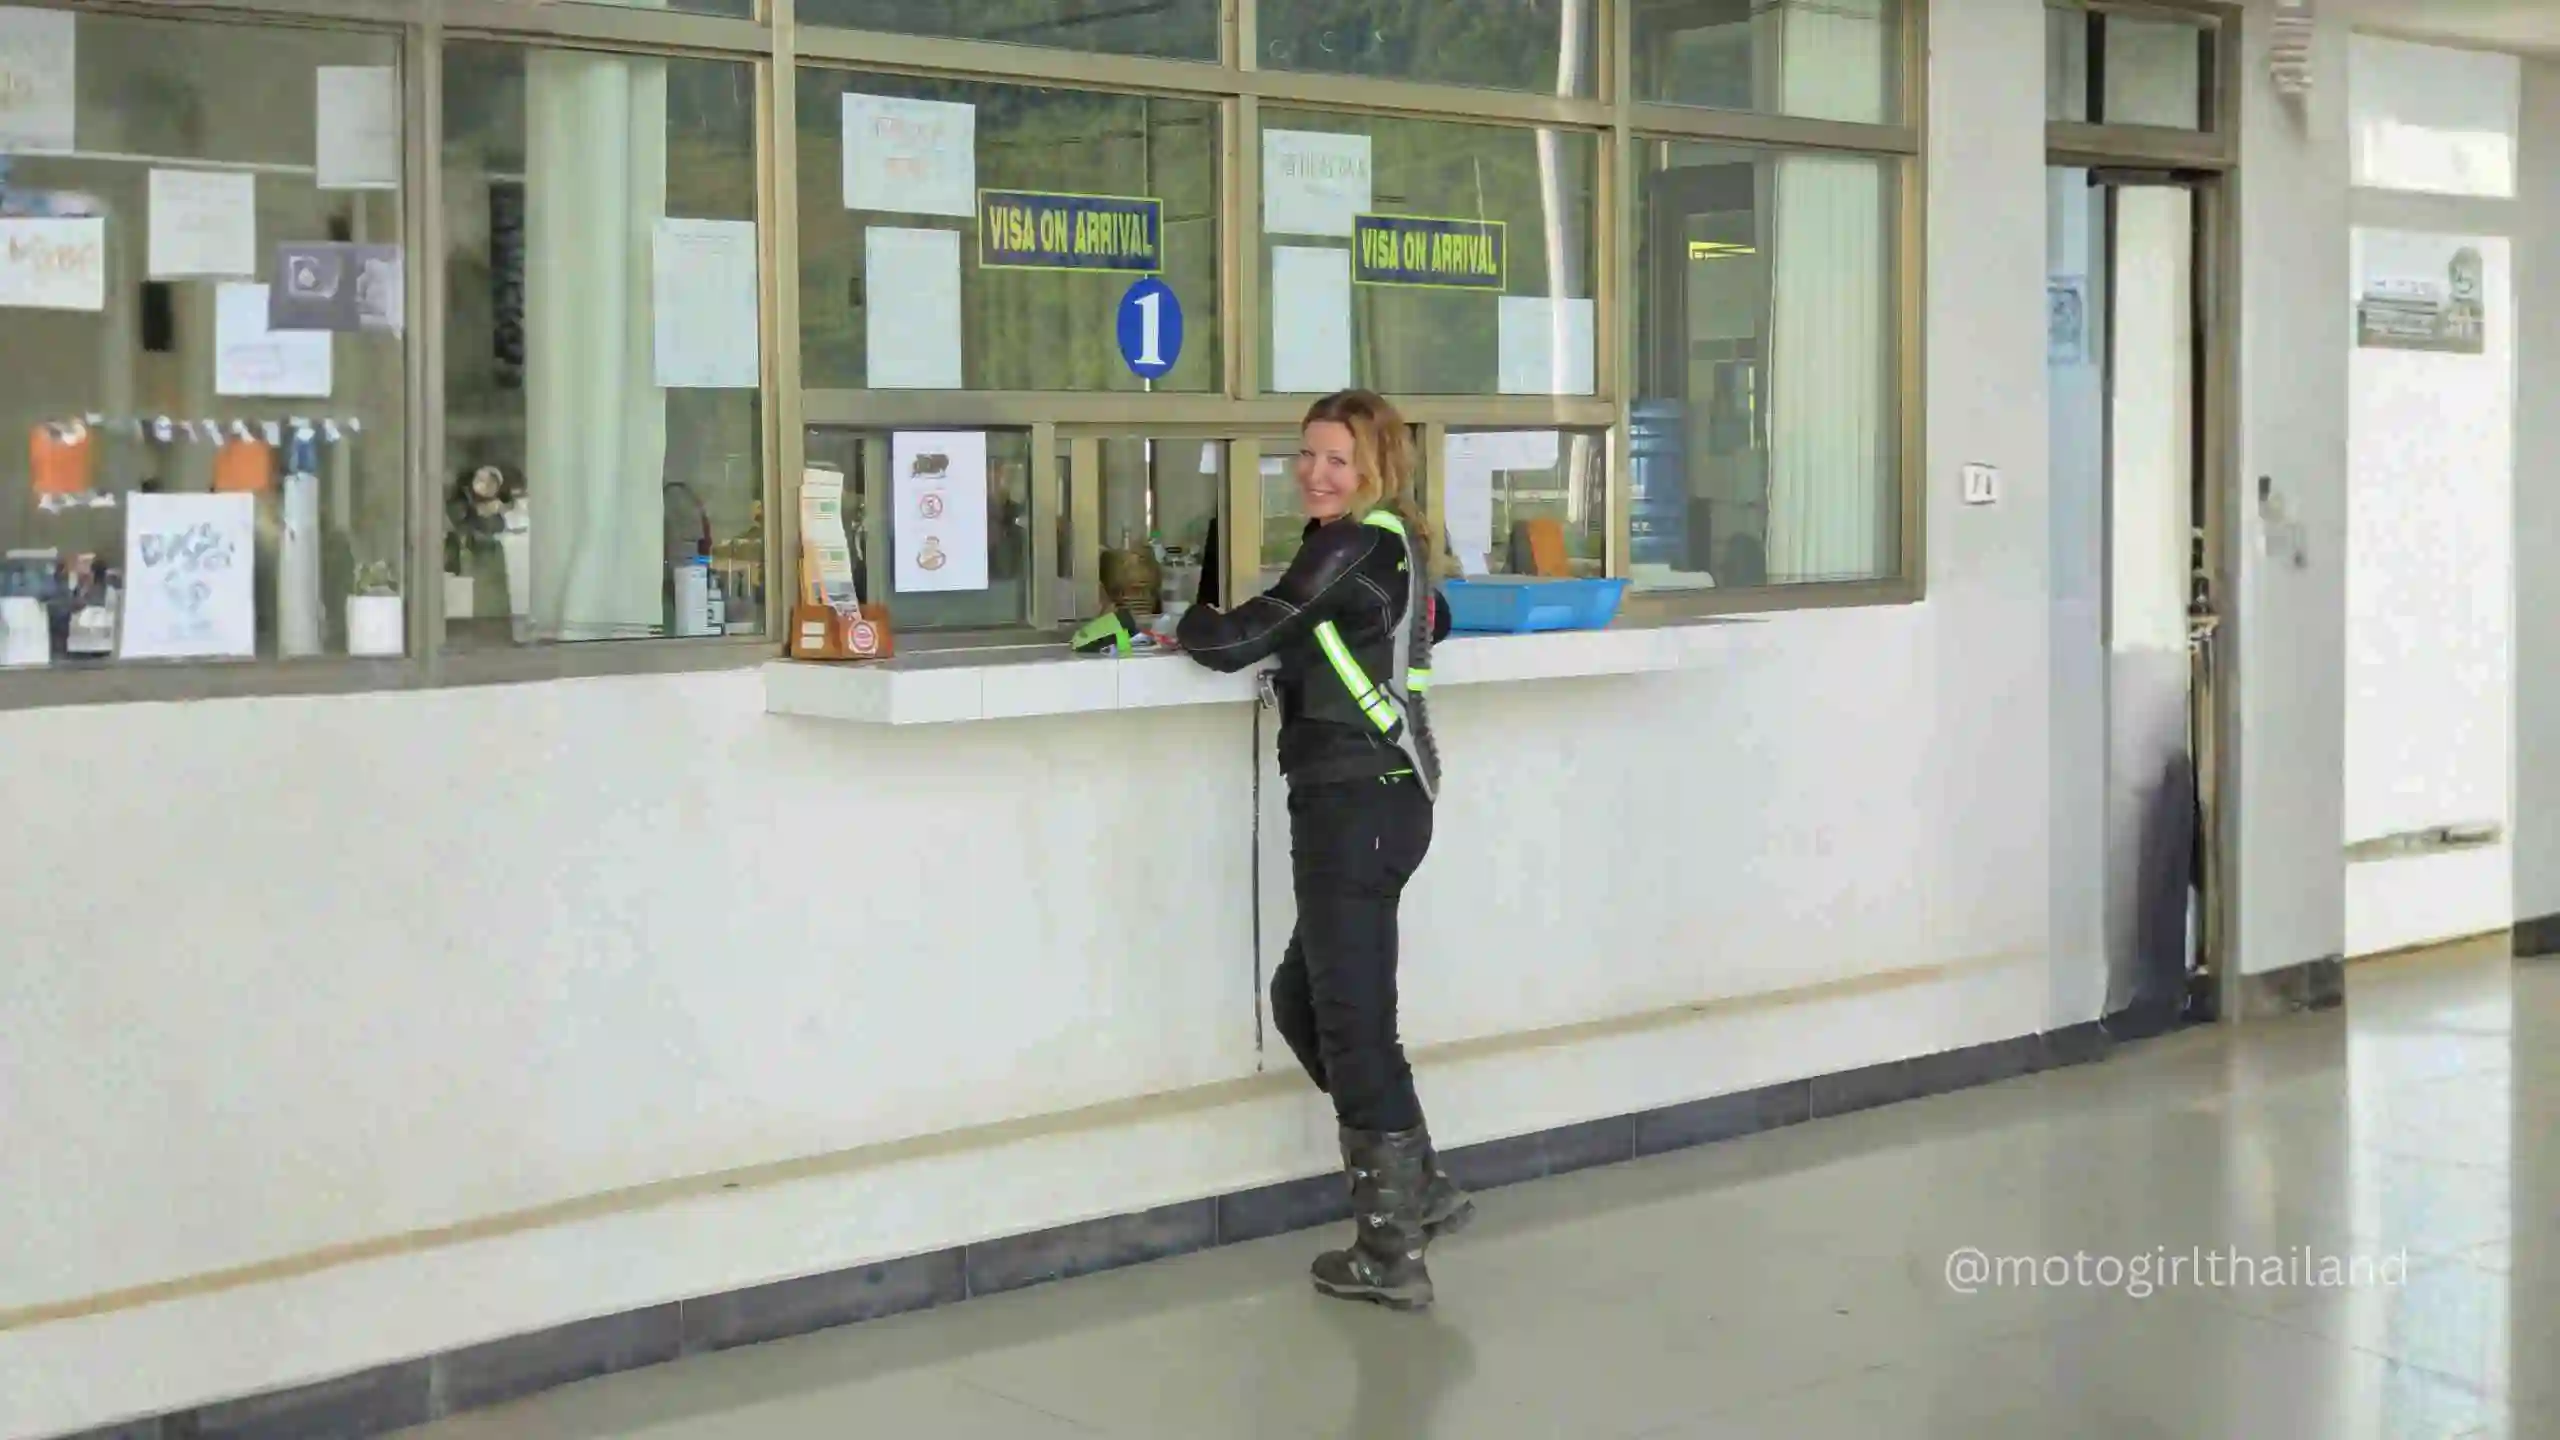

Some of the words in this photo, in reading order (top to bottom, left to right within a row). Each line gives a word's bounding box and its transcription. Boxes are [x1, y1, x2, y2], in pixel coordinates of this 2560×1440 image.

[989, 204, 1036, 252] VISA
[1040, 208, 1069, 253] ON
[1074, 209, 1155, 256] ARRIVAL
[1361, 227, 1399, 270] VISA
[1403, 231, 1427, 271] ON
[1431, 231, 1498, 275] ARRIVAL
[1133, 292, 1167, 366] 1
